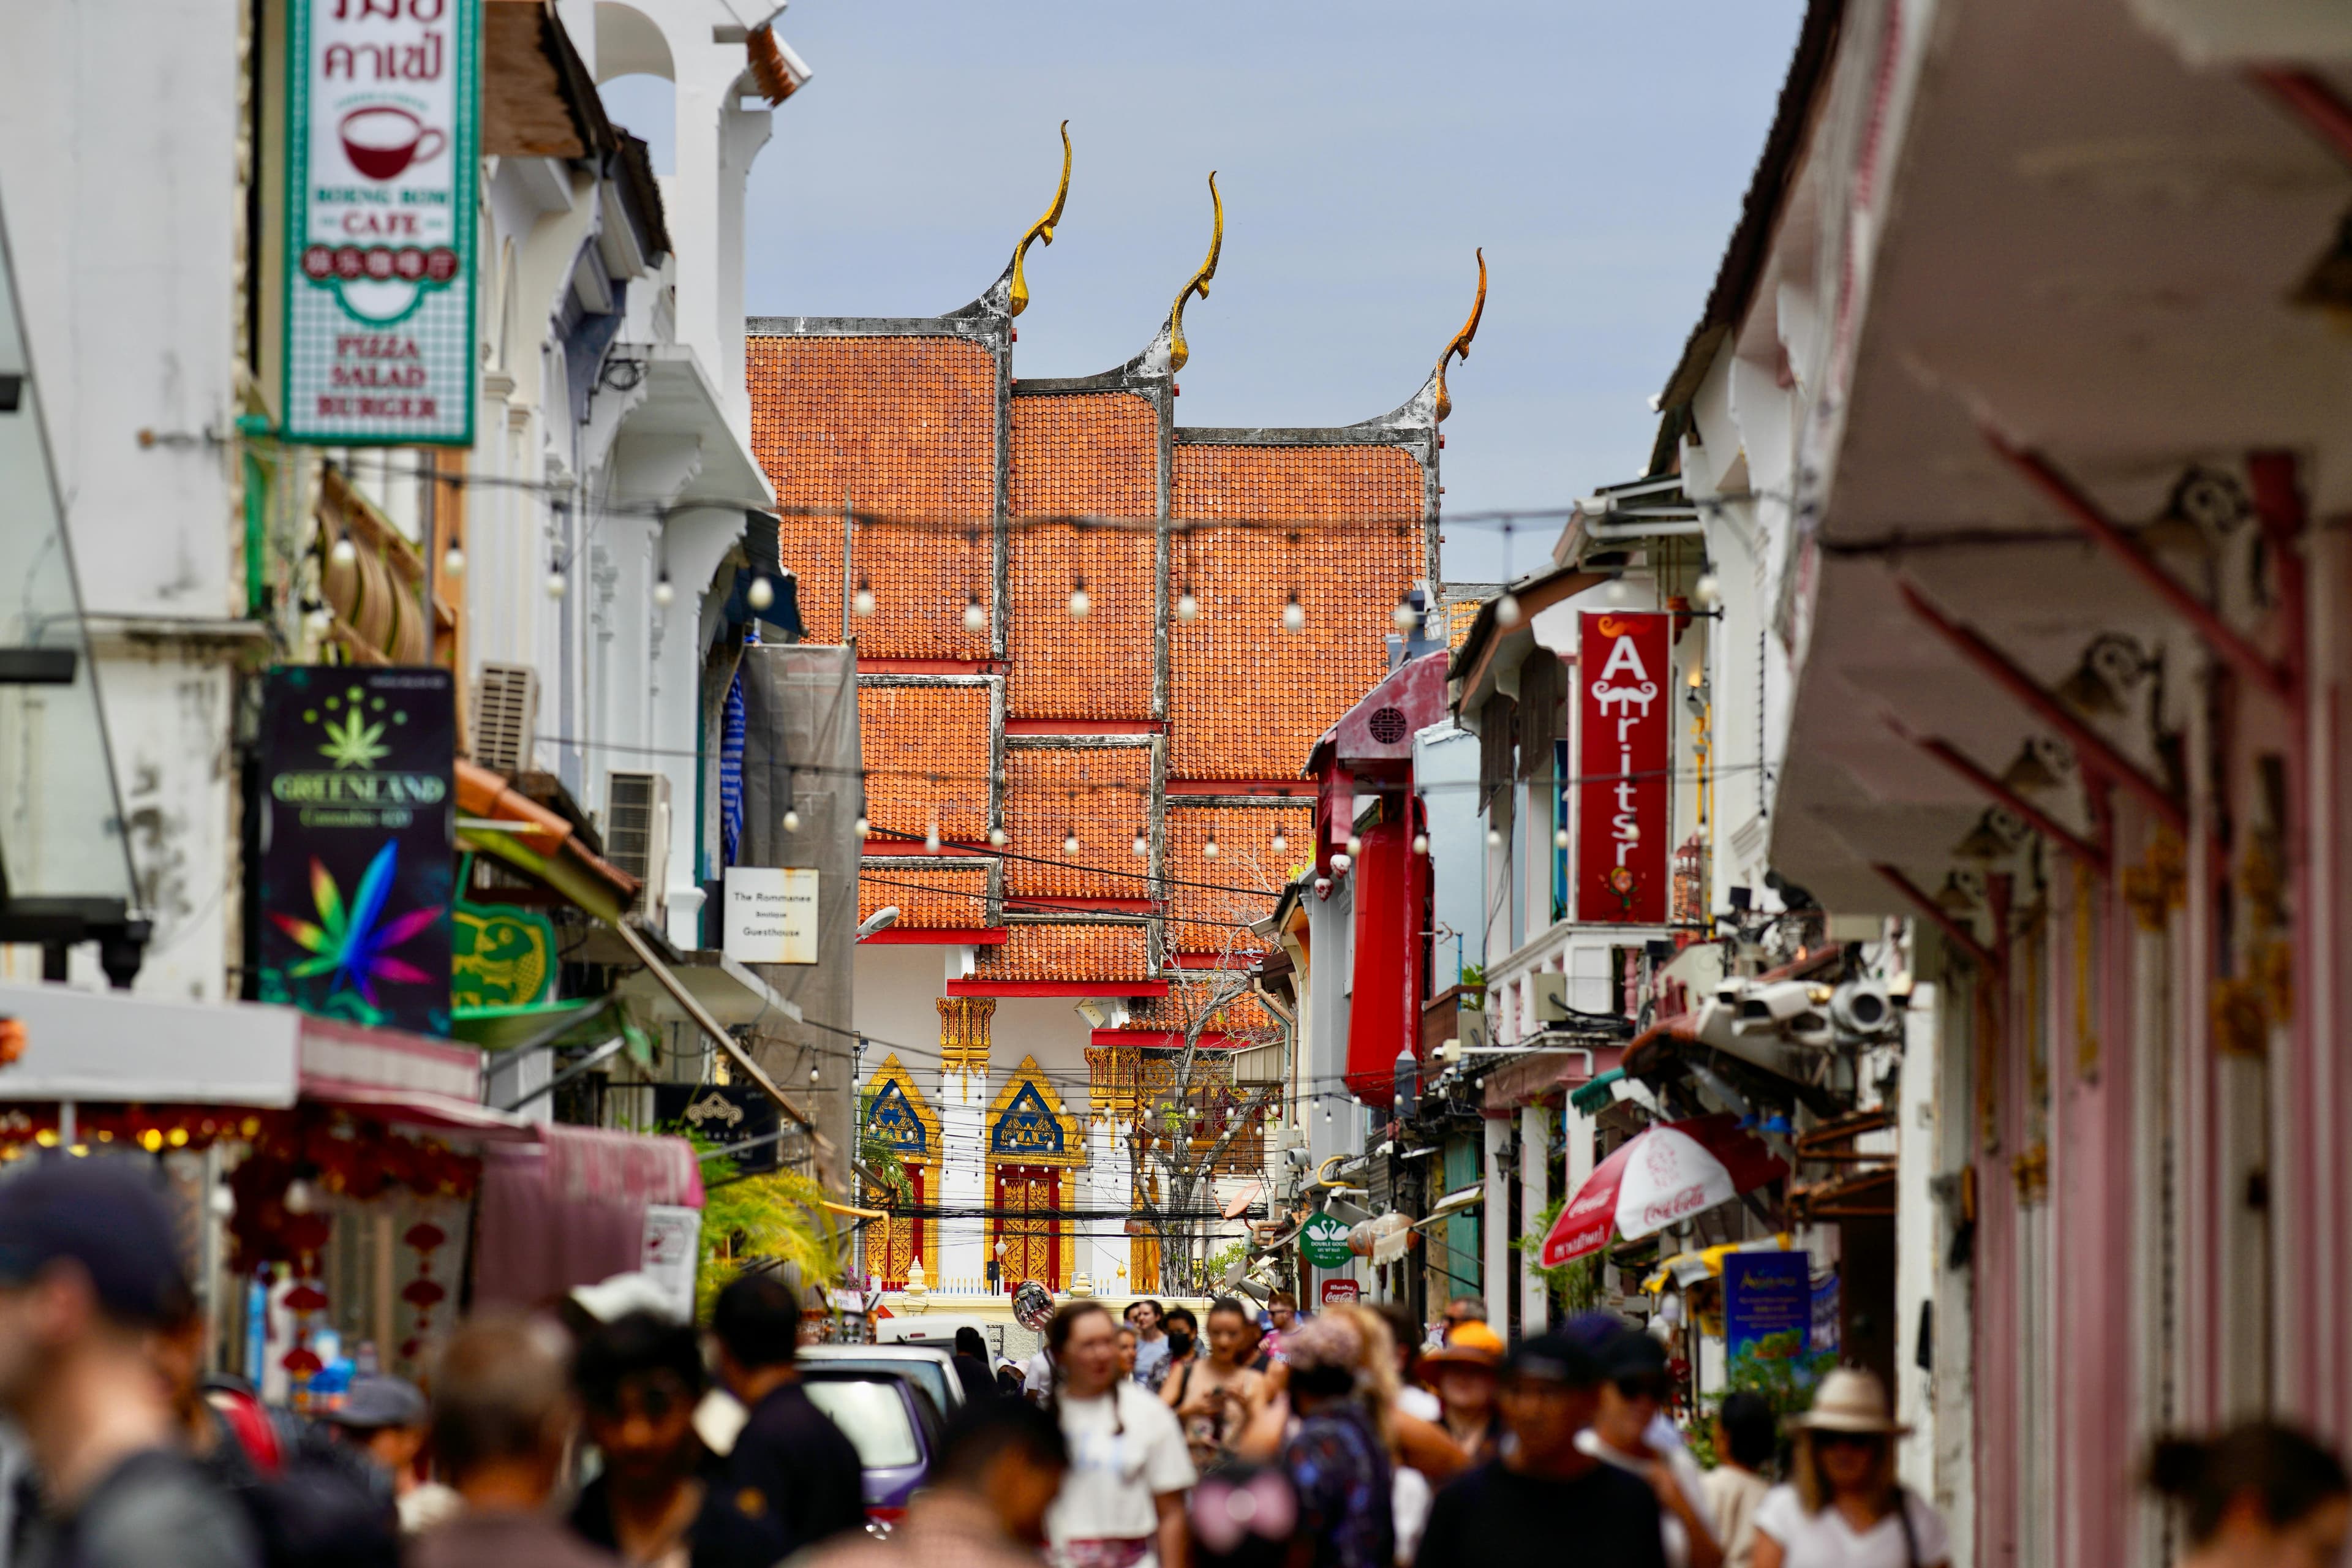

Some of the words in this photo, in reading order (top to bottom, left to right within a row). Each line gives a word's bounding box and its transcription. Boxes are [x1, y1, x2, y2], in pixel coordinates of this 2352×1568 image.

[341, 211, 419, 236] CAFE
[336, 334, 420, 358] PIZZA
[331, 365, 426, 387] SALAD
[317, 396, 437, 418] BURGER
[271, 772, 447, 804] GREENLAND
[733, 892, 752, 902] The
[756, 892, 812, 903] Rommanee
[742, 927, 801, 937] Guesthouse
